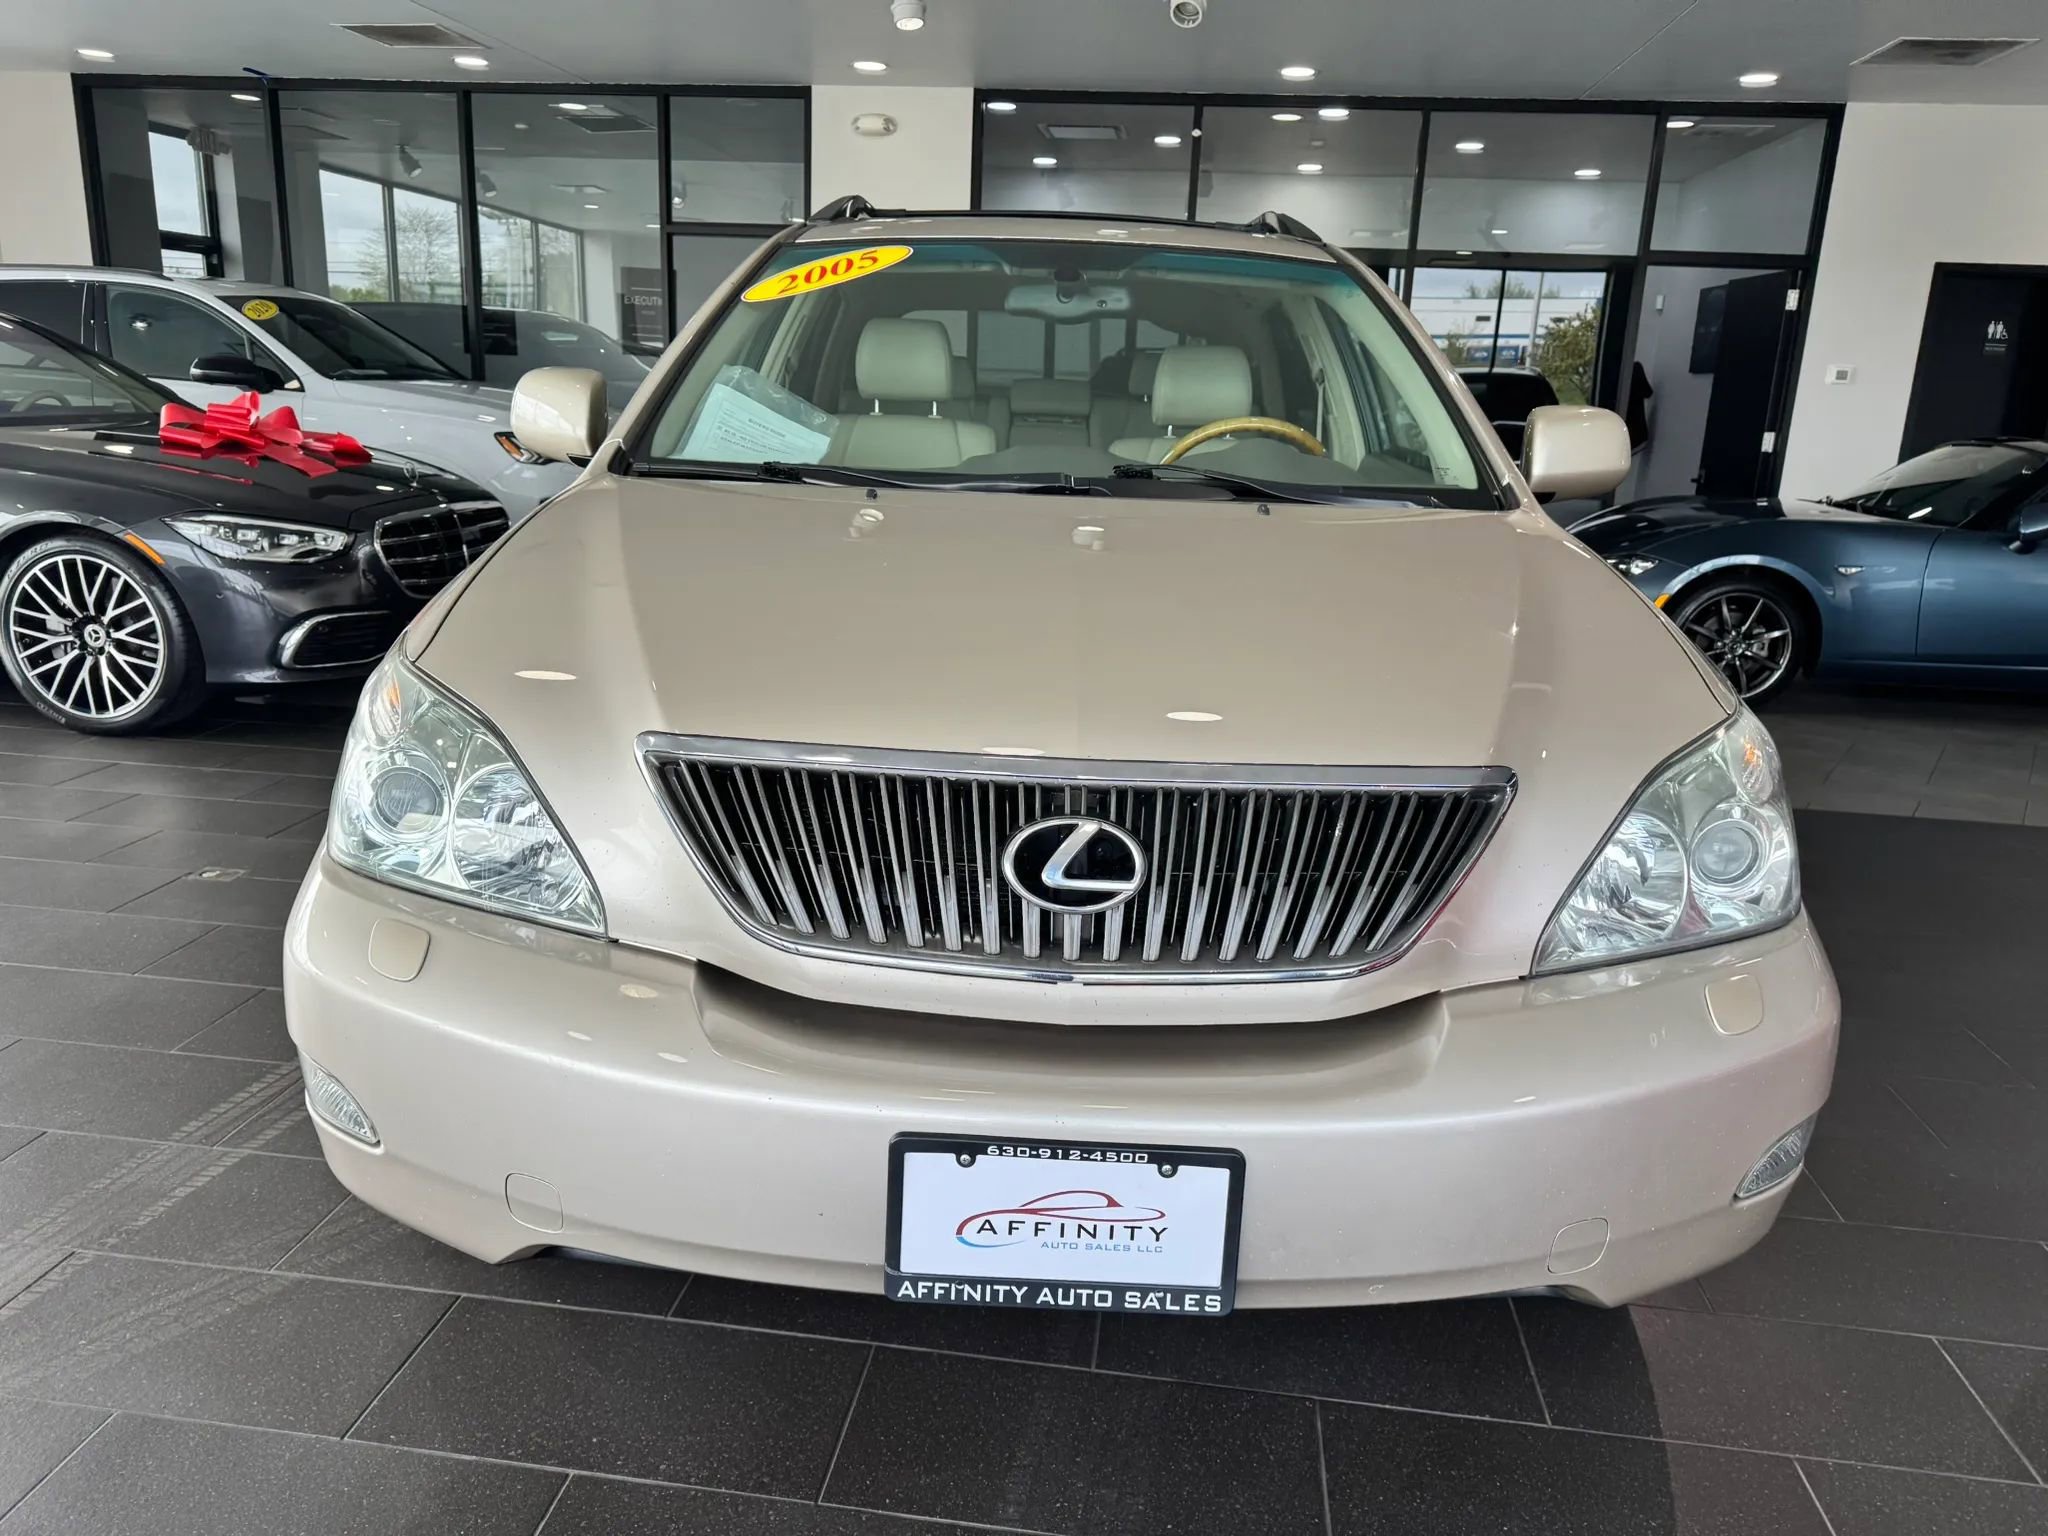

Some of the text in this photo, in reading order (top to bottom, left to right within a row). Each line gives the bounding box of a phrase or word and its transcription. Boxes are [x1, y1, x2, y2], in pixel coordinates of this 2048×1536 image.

[777, 249, 878, 295] 2005
[986, 1145, 1149, 1164] 630-912-4500
[976, 1218, 1169, 1243] AFFINITY
[1040, 1241, 1163, 1253] AUTO SALES LLC
[897, 1280, 1222, 1313] AFFINITY AUTO SALES
